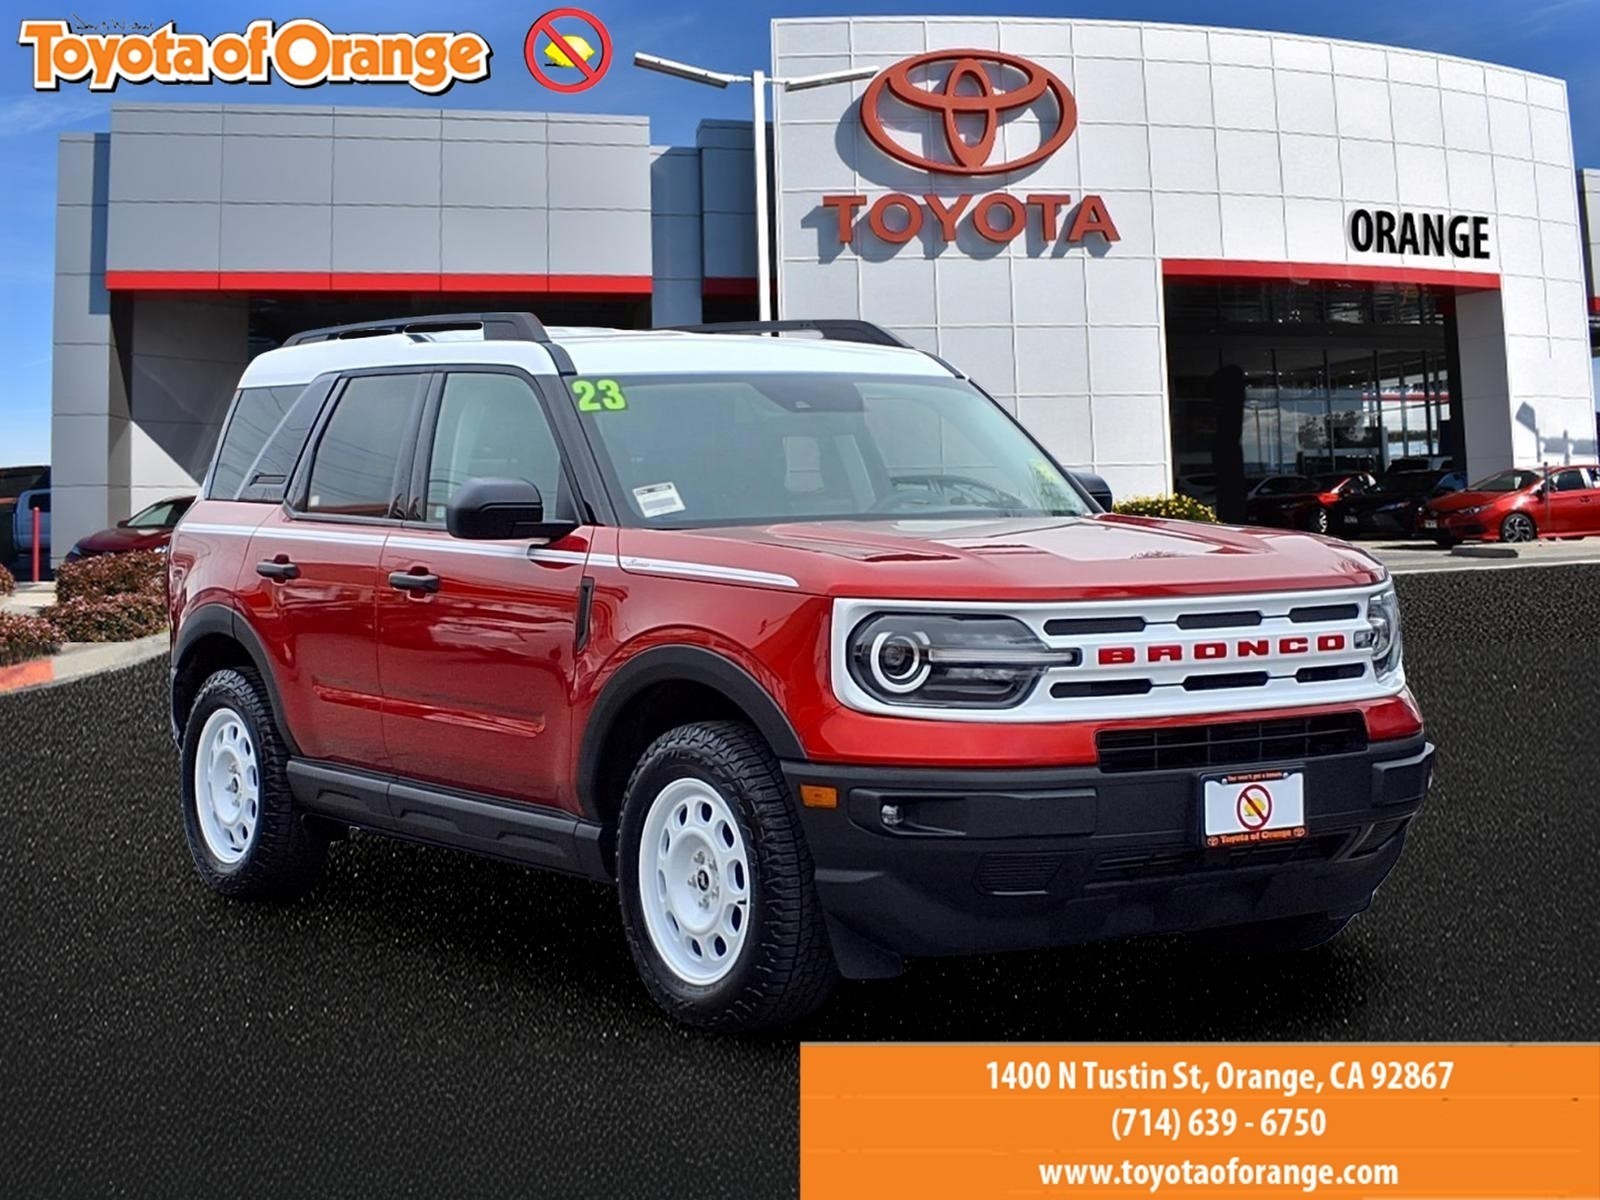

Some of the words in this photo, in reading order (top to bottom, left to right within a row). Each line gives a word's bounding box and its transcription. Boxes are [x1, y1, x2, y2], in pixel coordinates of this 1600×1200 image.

[823, 193, 1119, 244] TOYOTA
[1350, 209, 1490, 259] ORANGE
[571, 379, 627, 412] 23
[1097, 634, 1346, 665] BRONCO
[1220, 833, 1249, 844] Toyota
[1250, 832, 1260, 841] of
[1261, 829, 1292, 840] Orange
